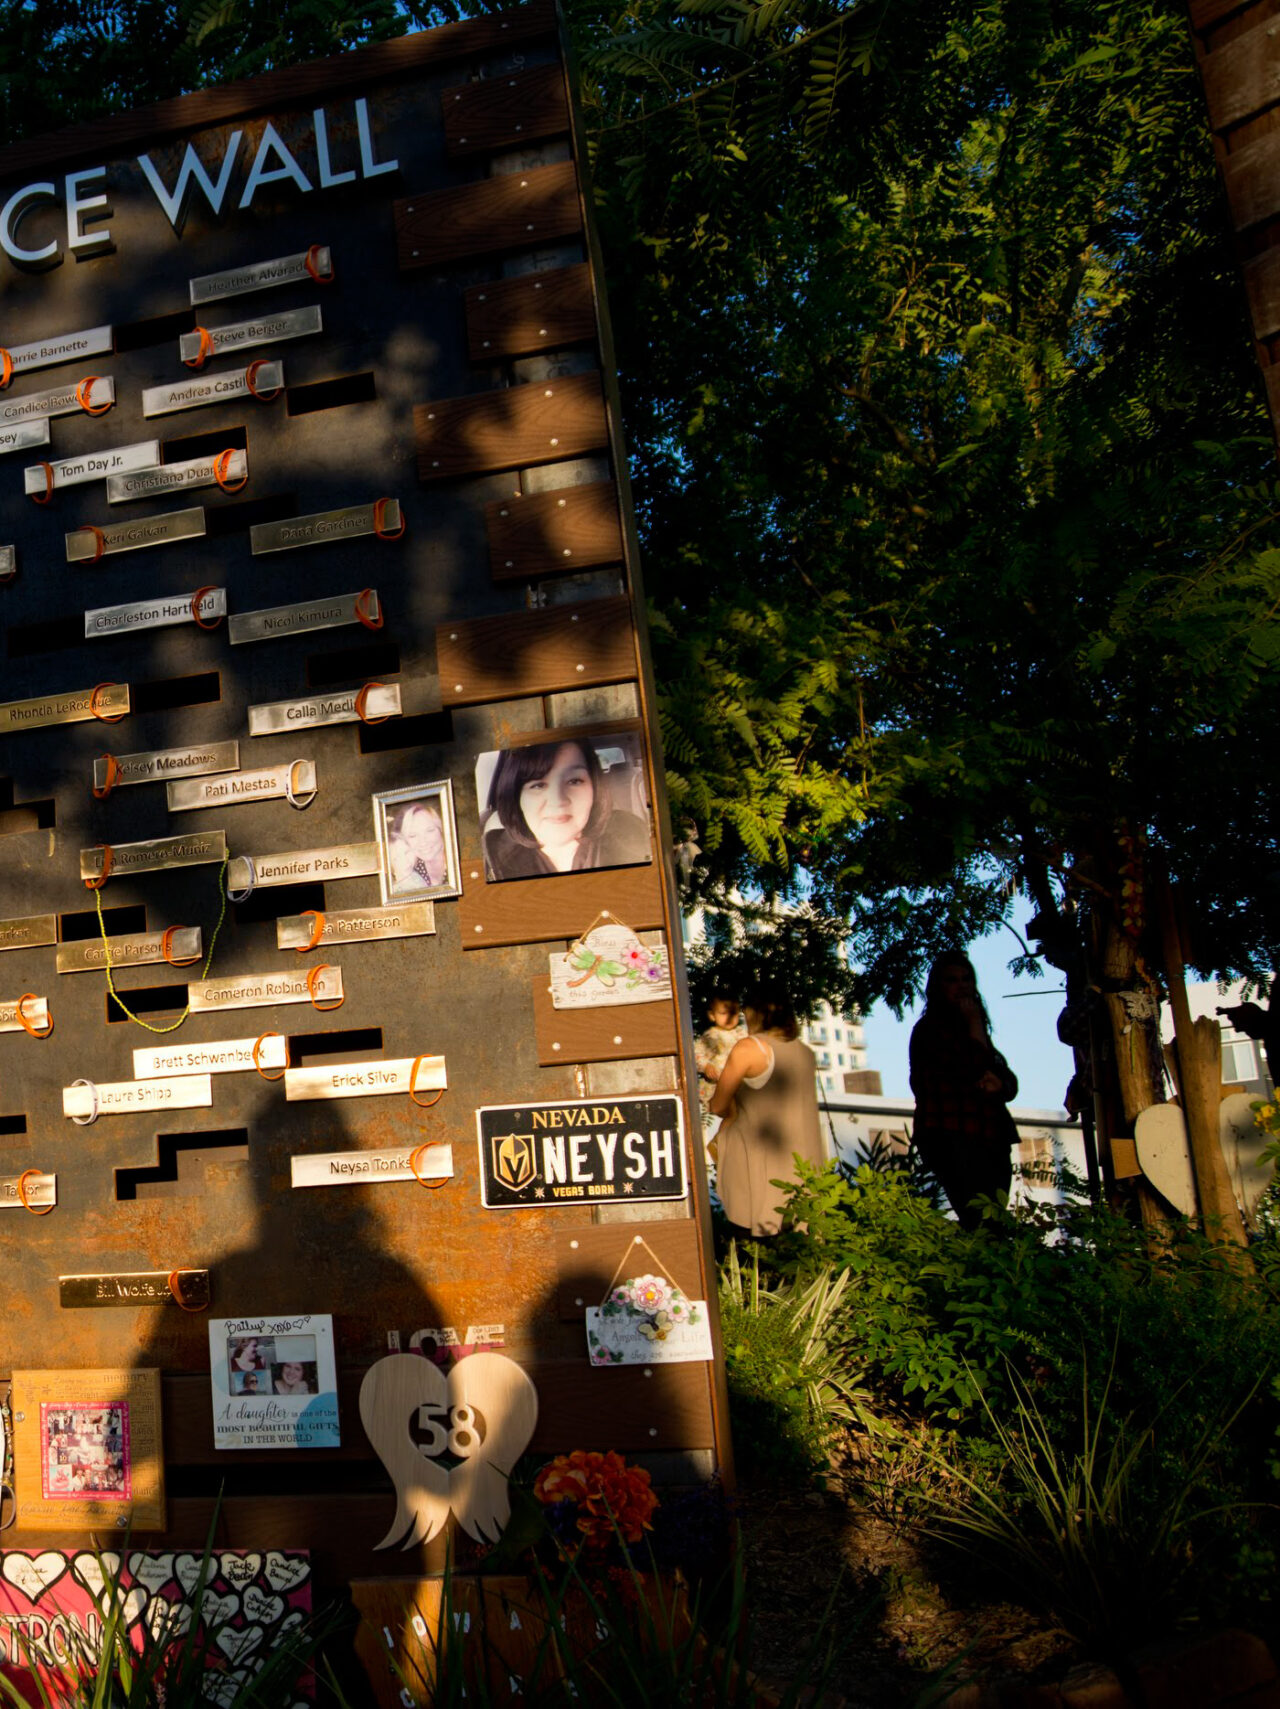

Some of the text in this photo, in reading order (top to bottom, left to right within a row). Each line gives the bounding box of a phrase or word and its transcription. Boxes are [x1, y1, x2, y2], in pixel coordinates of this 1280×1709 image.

[136, 97, 400, 216] WALL
[208, 274, 256, 292] Heather
[212, 320, 288, 346] Steve Berger
[9, 339, 88, 366] arrie Barnette
[169, 374, 257, 404] Andrea Castila
[4, 401, 48, 418] Candice
[60, 455, 123, 478] Tom Day Jr.
[125, 471, 184, 492] Christiana
[102, 524, 168, 546] Keri Galvan
[281, 515, 368, 541] Dana Gardner
[95, 597, 215, 629] Charleston Hartfeld
[263, 605, 343, 631] Nicol Kimura
[9, 702, 55, 722] Rhonda
[286, 700, 360, 721] Calla Medi
[115, 751, 217, 777] Kelsey Meadows
[205, 777, 278, 798] Pati Mestas
[94, 854, 119, 868] Lia
[259, 856, 350, 879] Jennifer Parks
[309, 914, 401, 935] Lsa Patterson
[204, 984, 264, 1001] Cameron
[152, 1048, 265, 1069] Brett Schwanbek
[331, 1070, 398, 1088] Erick Silva
[101, 1086, 172, 1104] Laura Shipp
[531, 1106, 626, 1129] NEVADA
[329, 1156, 413, 1175] Neysa Tonks
[542, 1129, 674, 1185] NEYSH
[552, 1185, 615, 1197] VEGAS BORN
[225, 1320, 265, 1337] Bailey
[219, 1403, 233, 1420] A
[236, 1401, 288, 1428] daughter
[243, 1434, 313, 1444] IN THE WORLD
[418, 1403, 482, 1459] 58
